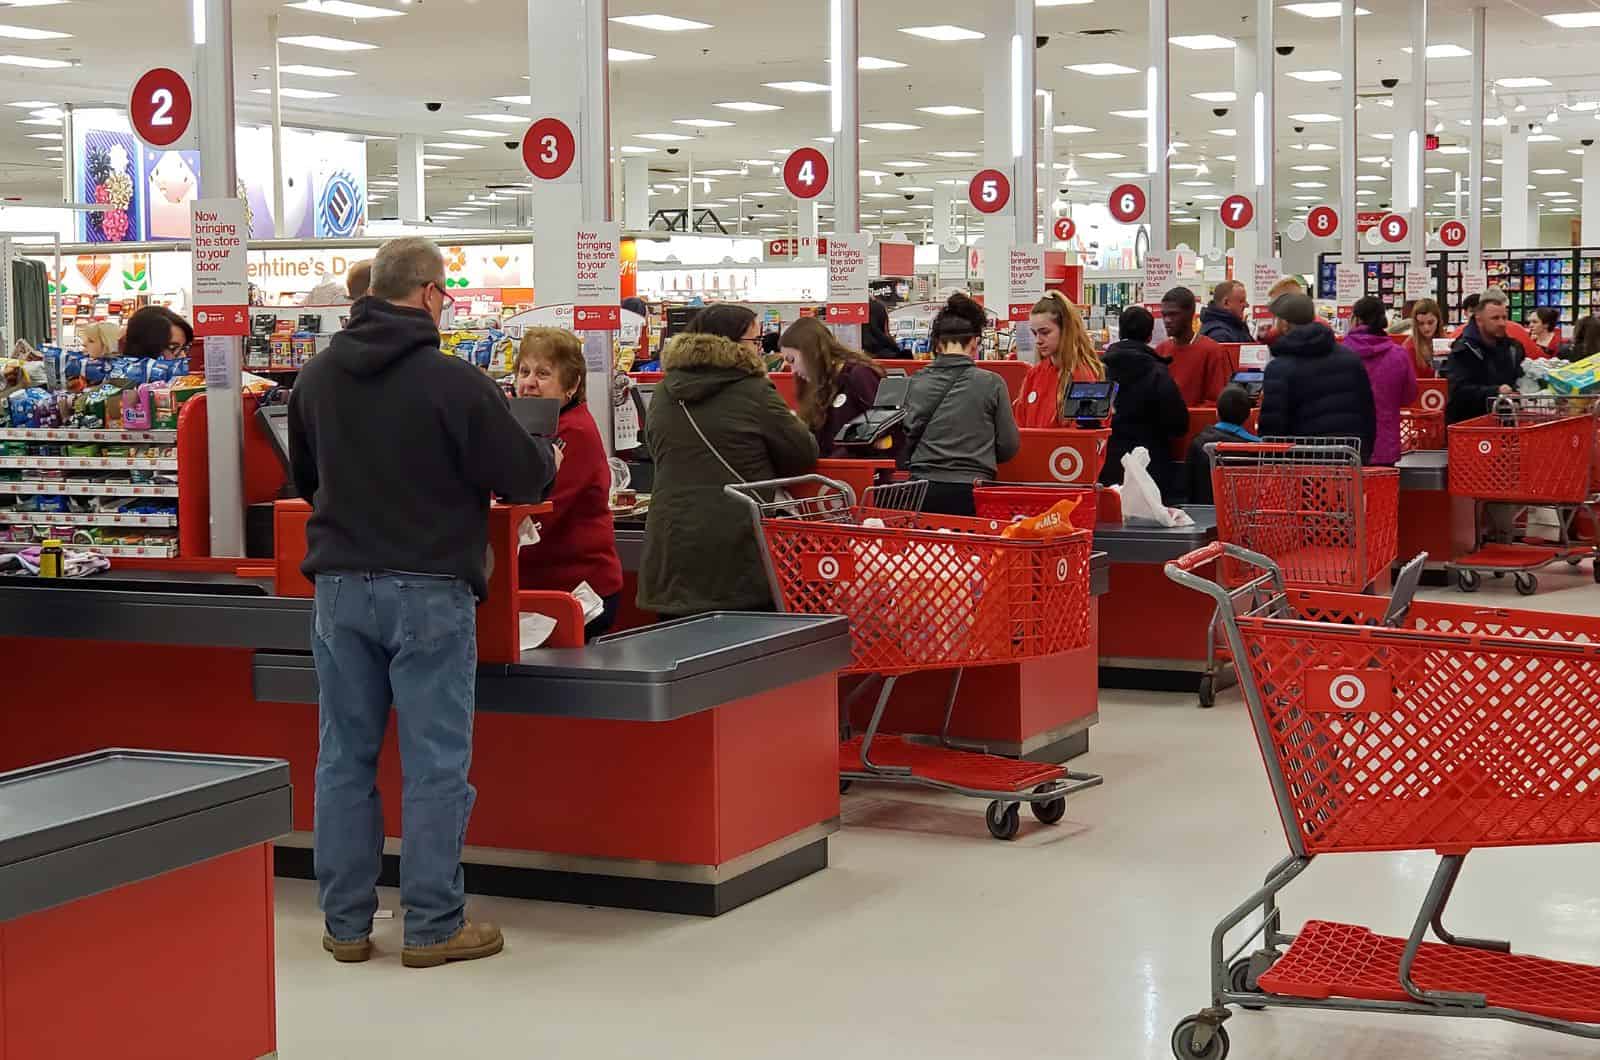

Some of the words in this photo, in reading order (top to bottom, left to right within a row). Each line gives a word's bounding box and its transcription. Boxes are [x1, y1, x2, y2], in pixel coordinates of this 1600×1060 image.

[151, 89, 173, 126] 2
[540, 135, 558, 164] 3
[797, 160, 816, 187] 4
[982, 180, 997, 203] 5
[1120, 193, 1136, 214] 6
[195, 211, 217, 221] Now
[1229, 202, 1244, 221] 7
[195, 223, 235, 235] bringing
[1317, 215, 1329, 230] 8
[1387, 221, 1400, 237] 9
[577, 231, 597, 240] Now
[1445, 227, 1461, 241] 10
[196, 237, 212, 246] the
[214, 237, 240, 246] store
[577, 241, 611, 251] bringing
[197, 249, 206, 258] to
[208, 250, 230, 261] your
[577, 251, 591, 260] the
[593, 251, 615, 260] store
[830, 249, 860, 258] bringing
[247, 256, 325, 277] entine's
[577, 261, 586, 270] to
[588, 262, 606, 271] your
[840, 267, 855, 275] your
